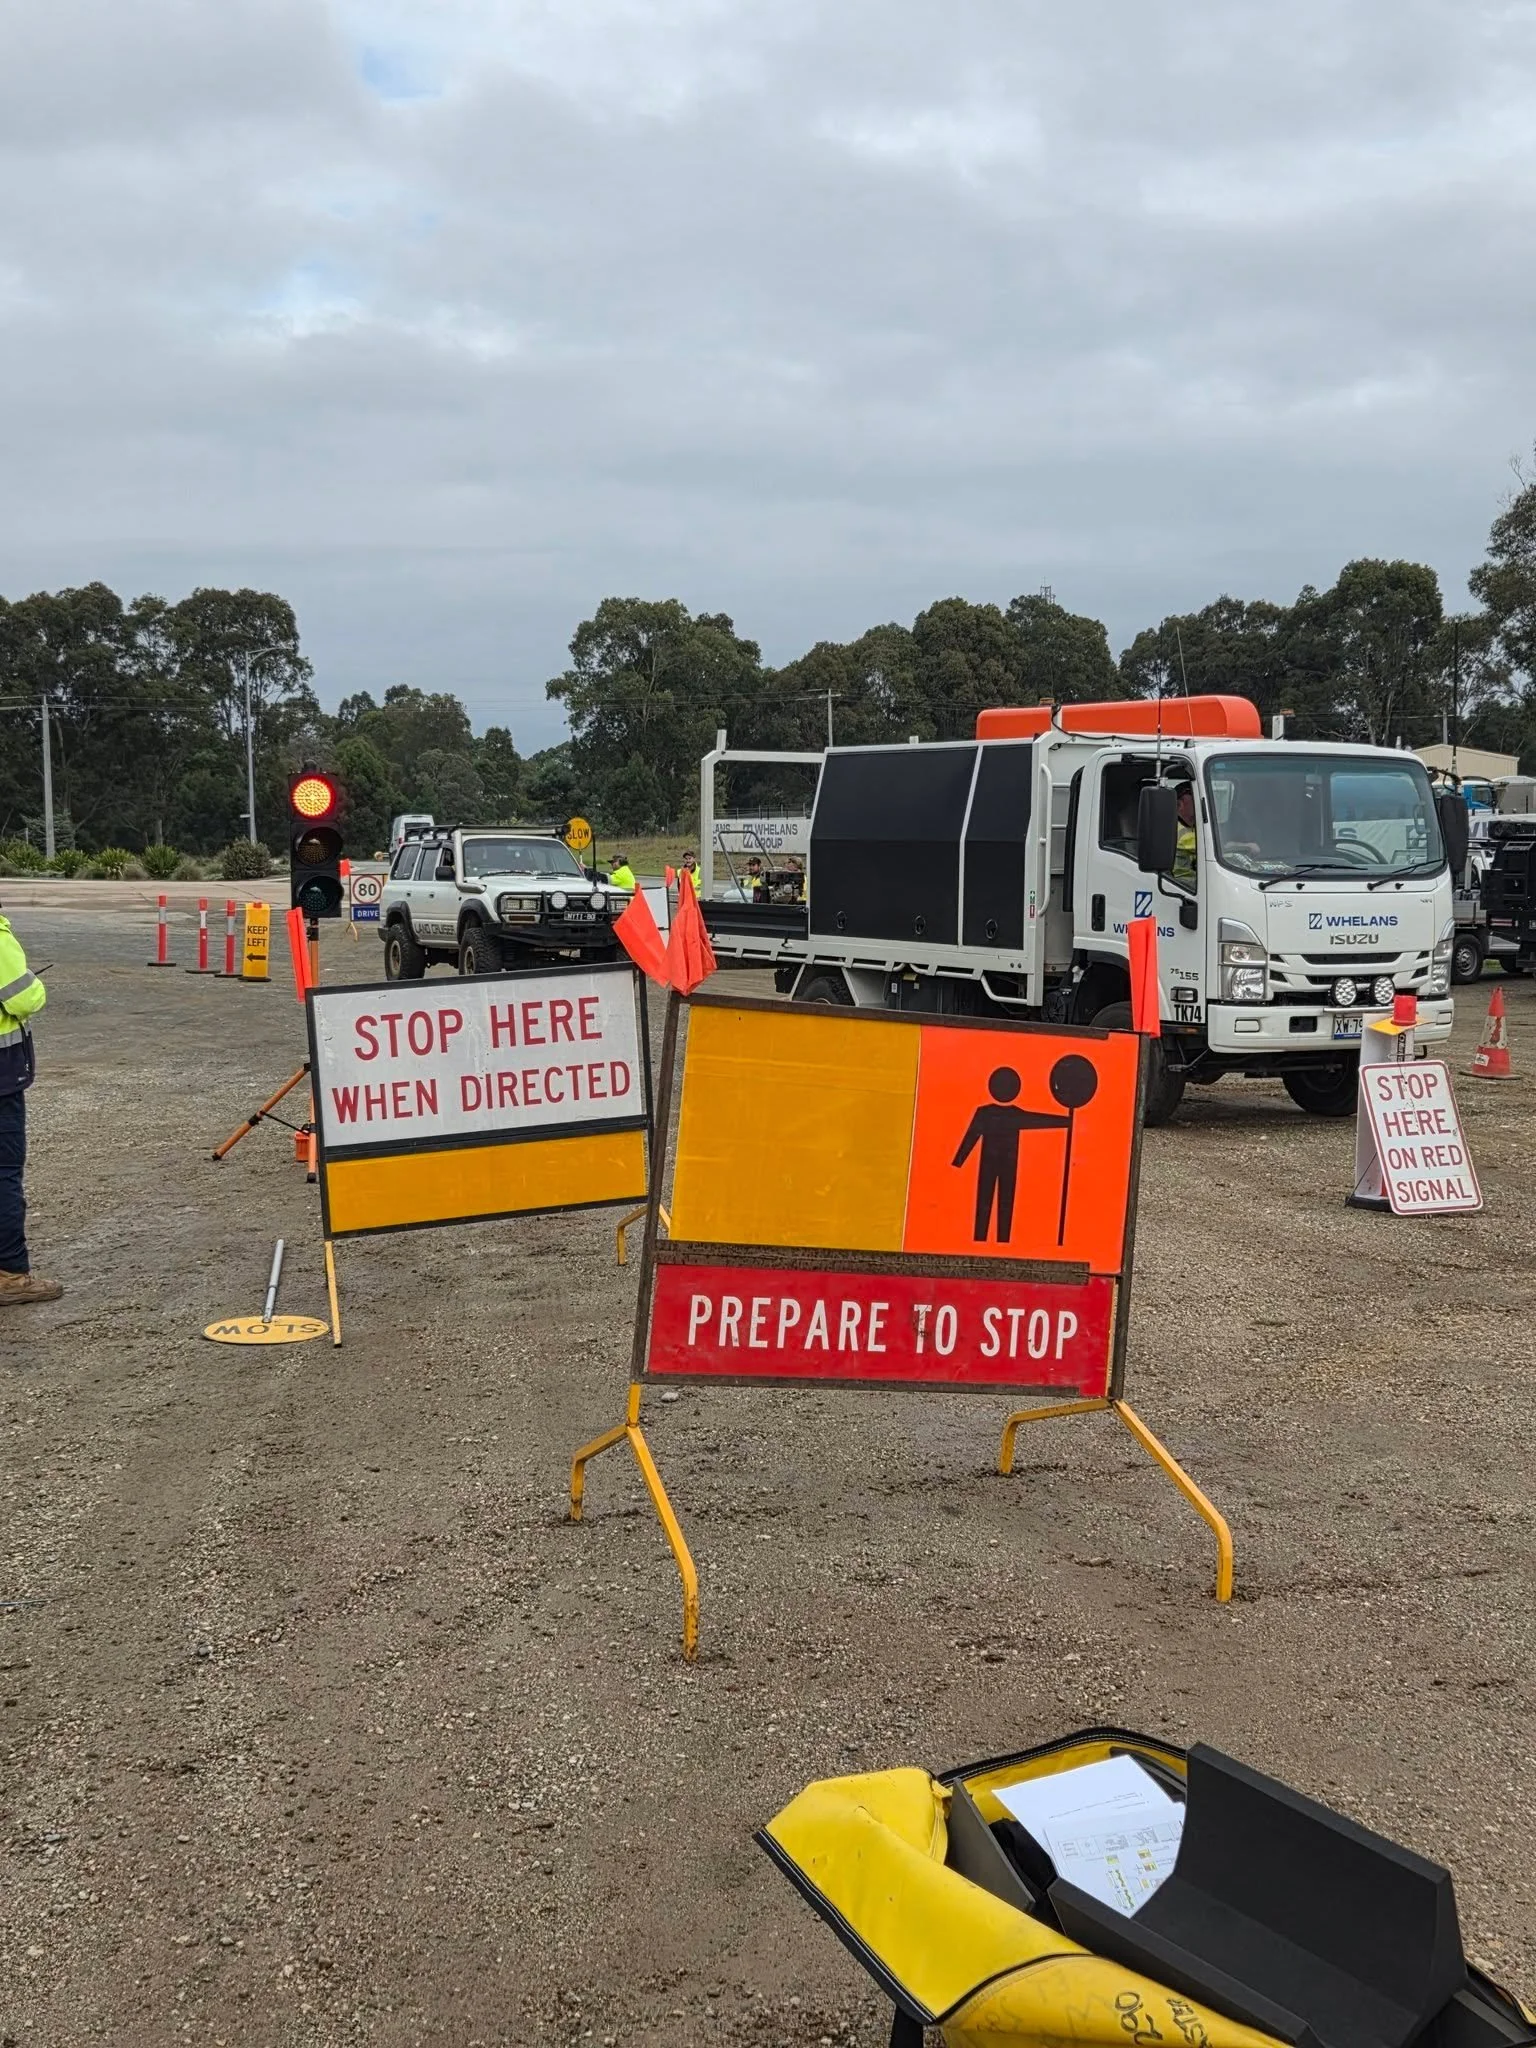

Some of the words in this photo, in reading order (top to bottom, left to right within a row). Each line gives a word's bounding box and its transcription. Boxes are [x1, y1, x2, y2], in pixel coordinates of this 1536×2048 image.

[755, 824, 798, 835] WHELANS
[358, 883, 377, 897] 80
[357, 909, 379, 917] DRIVE
[1326, 916, 1398, 927] WHELANS
[247, 926, 268, 935] KEEP
[247, 938, 267, 947] LEFT
[1330, 934, 1379, 945] ISUZU
[1174, 1004, 1202, 1023] TK74
[354, 1009, 463, 1061] STOP
[490, 996, 602, 1048] HERE
[332, 1079, 438, 1124] WHEN
[461, 1061, 630, 1112] DIRECTED
[1377, 1073, 1438, 1101] STOP
[1382, 1109, 1451, 1138] HERE
[1388, 1147, 1418, 1170] ON
[1421, 1144, 1463, 1168] RED
[1397, 1178, 1472, 1203] SIGNAL
[213, 1323, 321, 1335] SLOW
[687, 1294, 889, 1353] PREPARE
[913, 1304, 958, 1356] TO
[980, 1307, 1078, 1360] STOP
